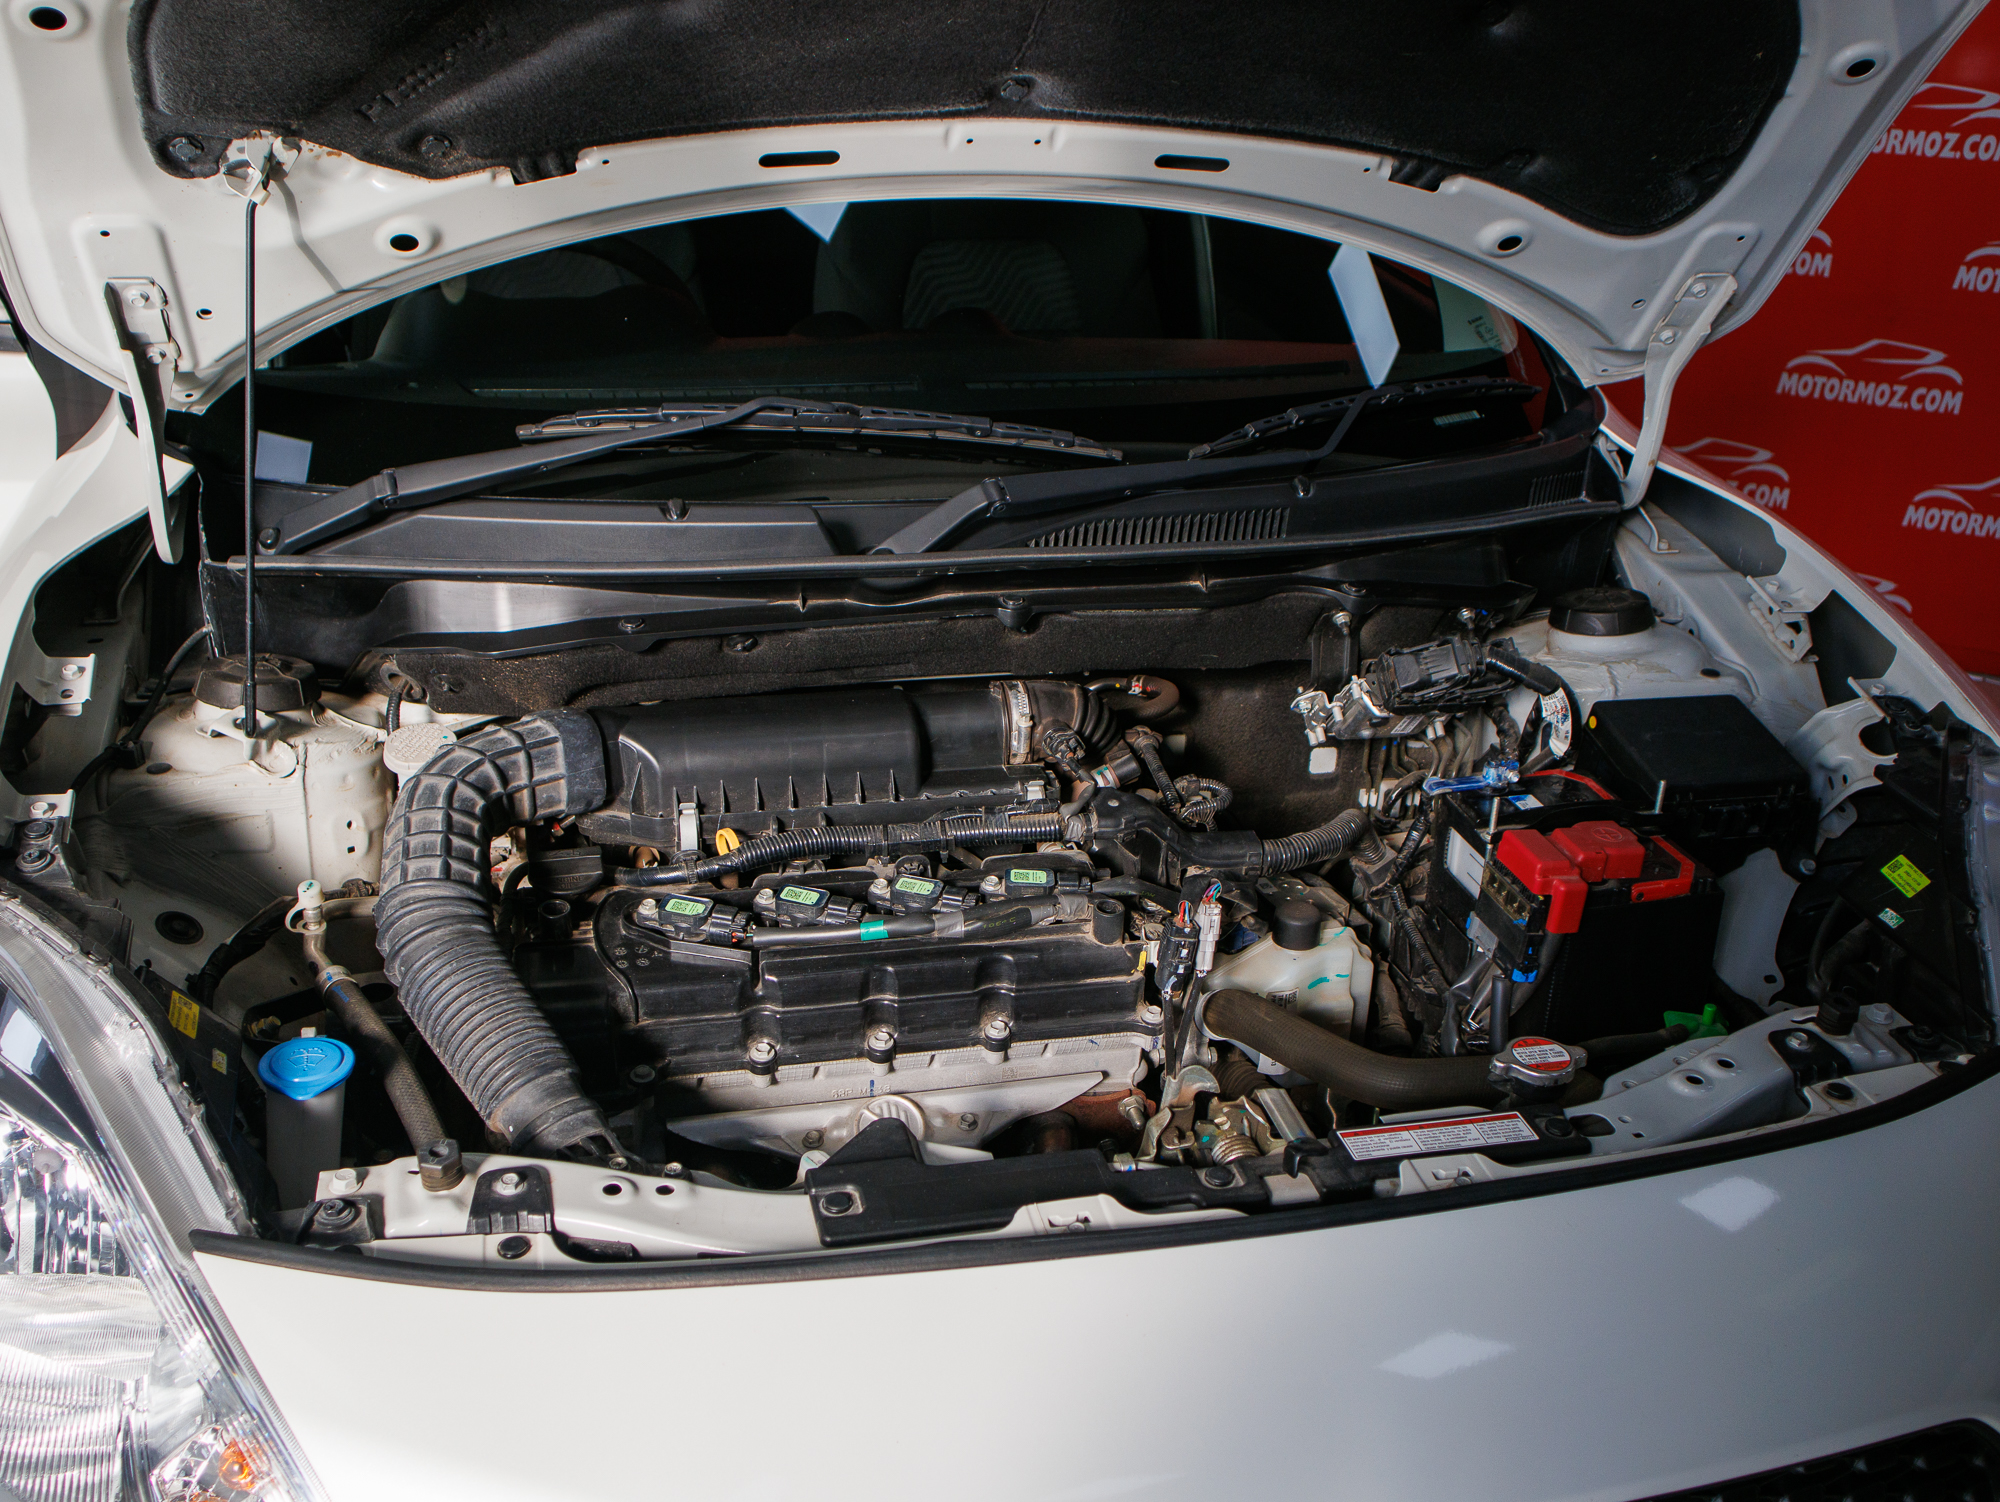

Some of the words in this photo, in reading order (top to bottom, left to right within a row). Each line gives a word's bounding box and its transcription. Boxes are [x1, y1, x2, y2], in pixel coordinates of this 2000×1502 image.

[1872, 128, 2000, 161] ORMOZ.CO
[1786, 251, 1833, 278] OM
[1776, 371, 1964, 415] MOTORMOZ.COM
